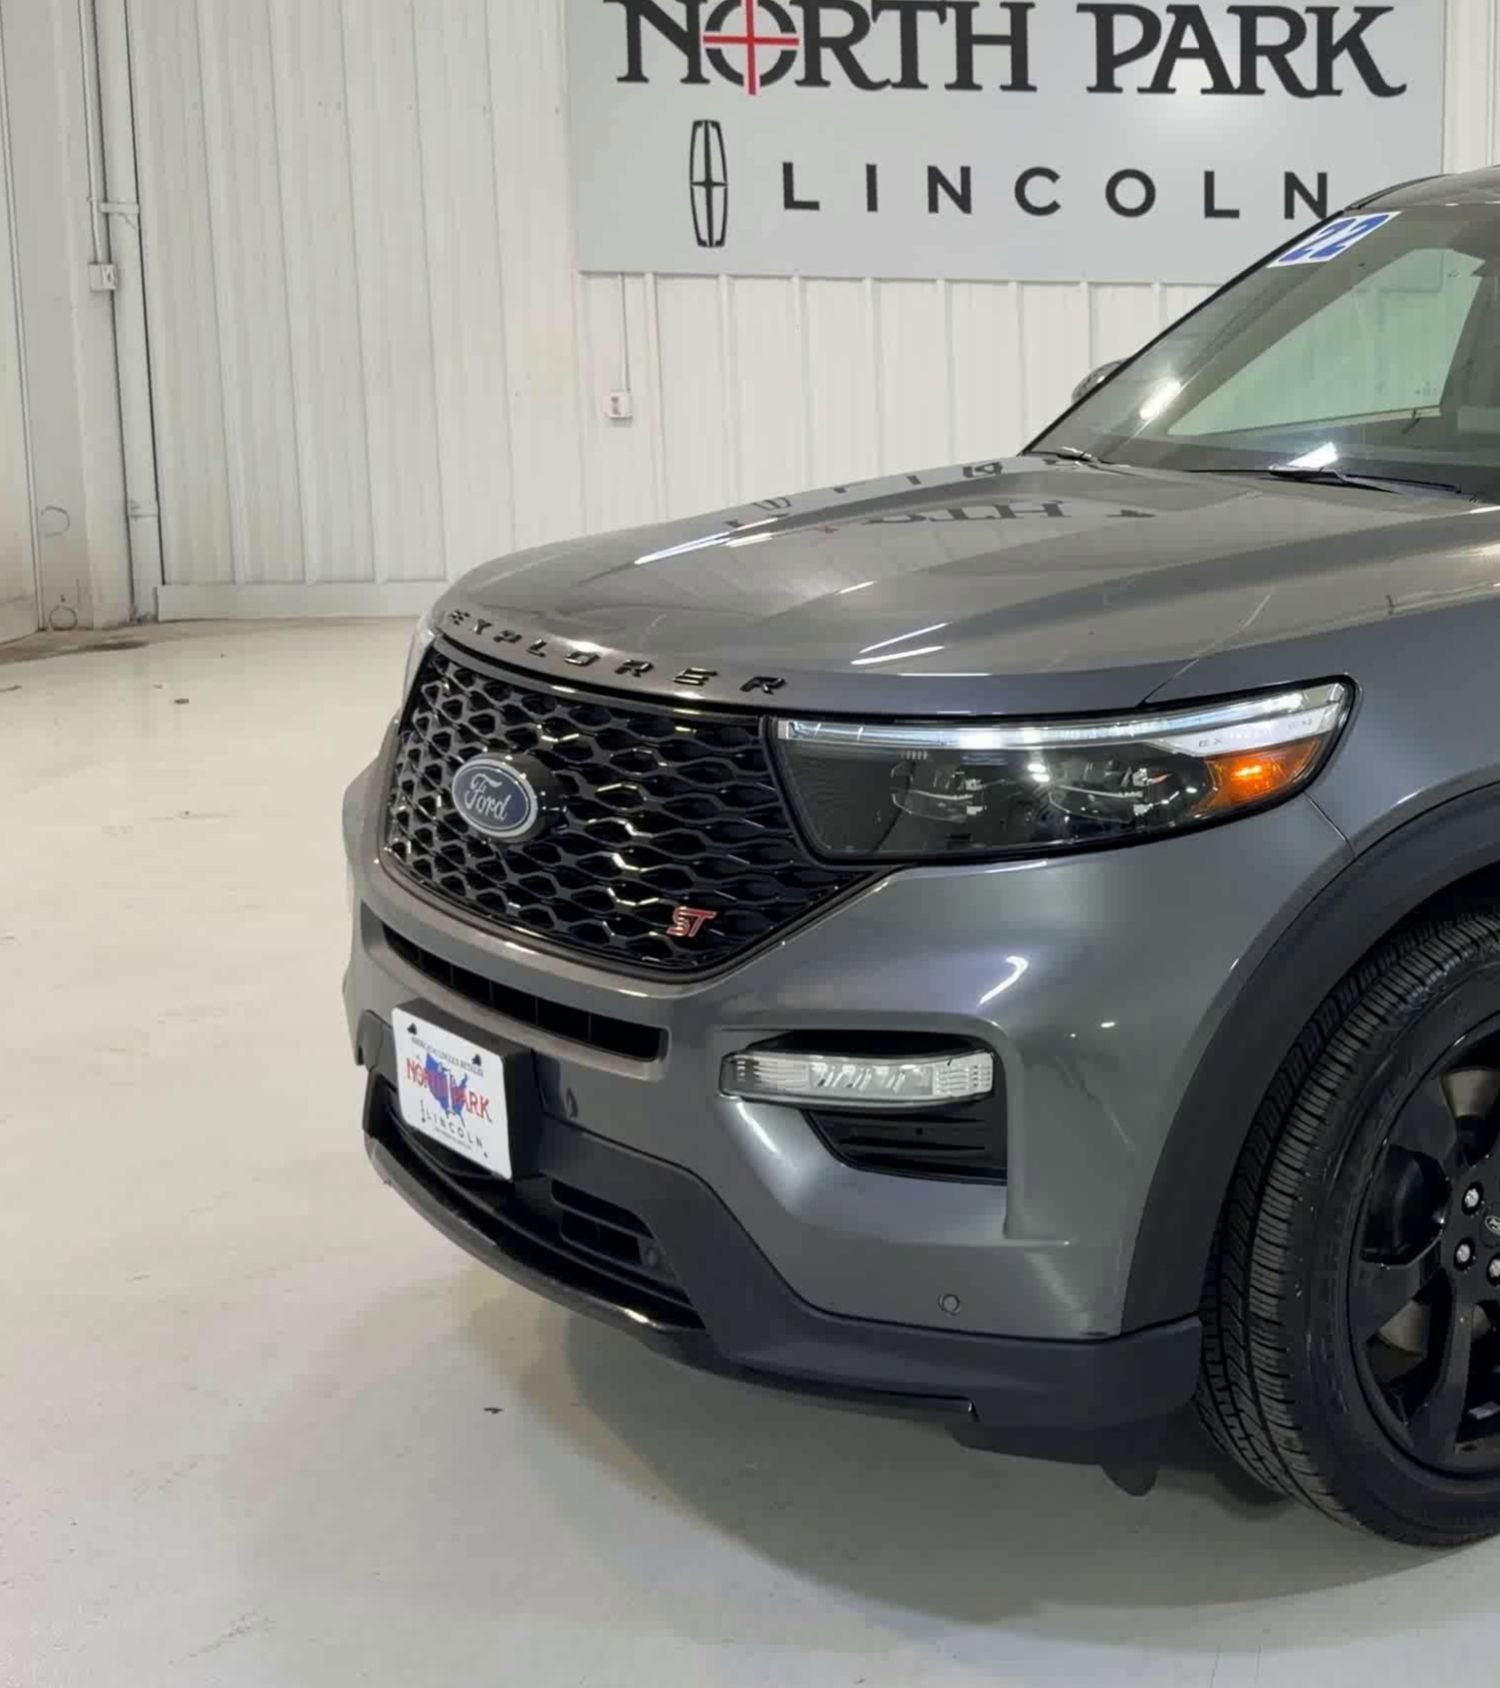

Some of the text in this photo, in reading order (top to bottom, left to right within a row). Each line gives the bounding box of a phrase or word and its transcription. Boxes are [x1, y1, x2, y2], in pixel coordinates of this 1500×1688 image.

[603, 0, 1408, 98] NORTH PARK
[782, 162, 1328, 220] LINCOLN
[1278, 214, 1390, 263] 22
[449, 609, 787, 695] EXPLORER
[463, 773, 513, 821] Ford
[666, 906, 718, 938] ST
[426, 1111, 484, 1149] LINCOLN
